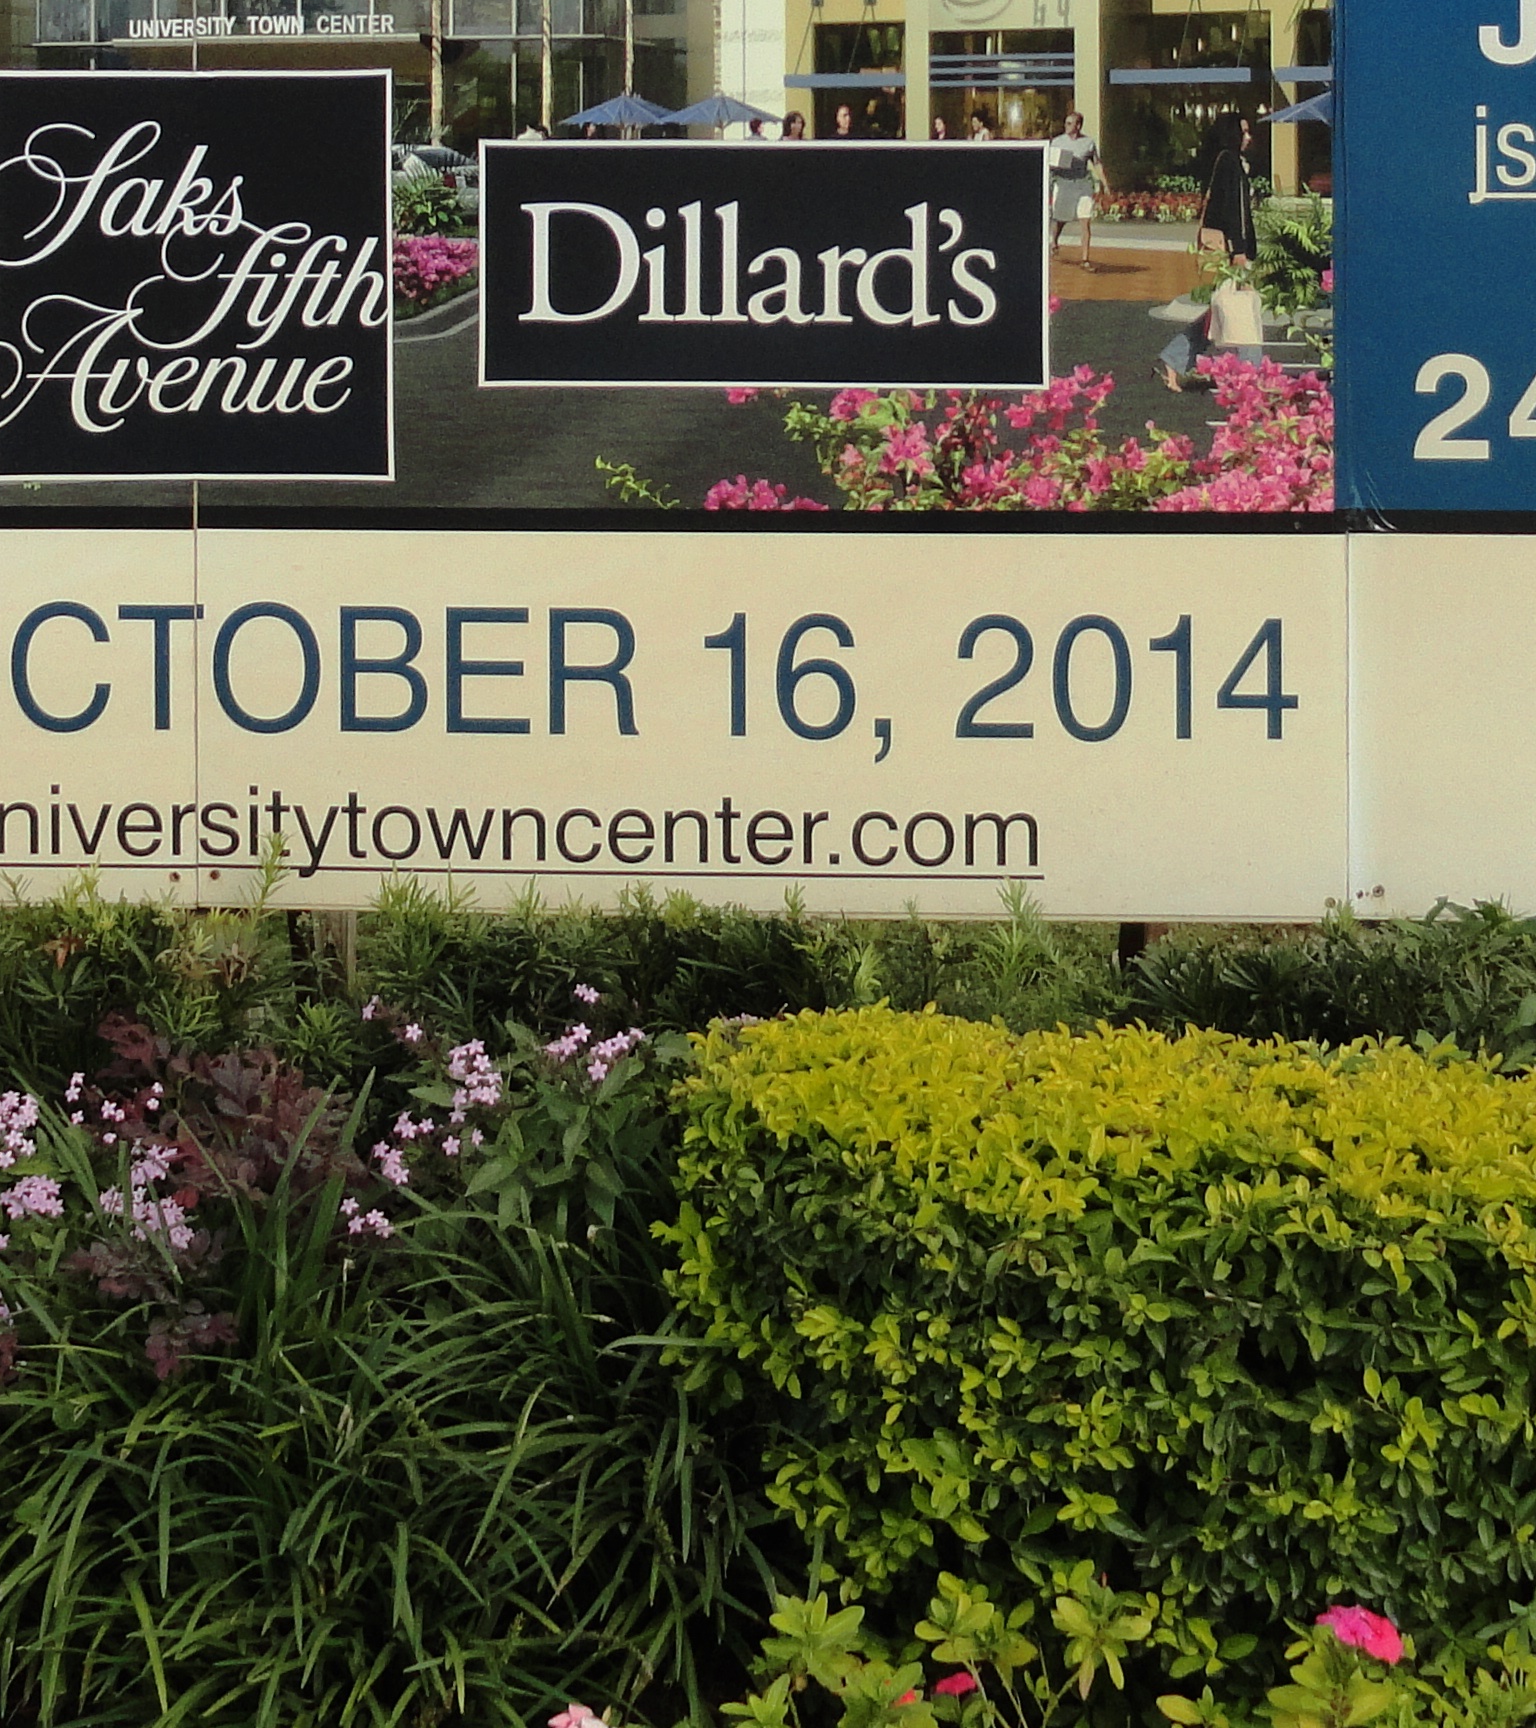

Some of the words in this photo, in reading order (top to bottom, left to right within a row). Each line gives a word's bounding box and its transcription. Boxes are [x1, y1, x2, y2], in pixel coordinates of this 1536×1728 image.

[128, 16, 237, 39] UNIVERSITY
[247, 15, 305, 37] TOWN
[316, 14, 395, 35] CENTER
[517, 199, 998, 329] Dillard's
[704, 612, 892, 764] 16,
[955, 614, 1299, 743] 2014
